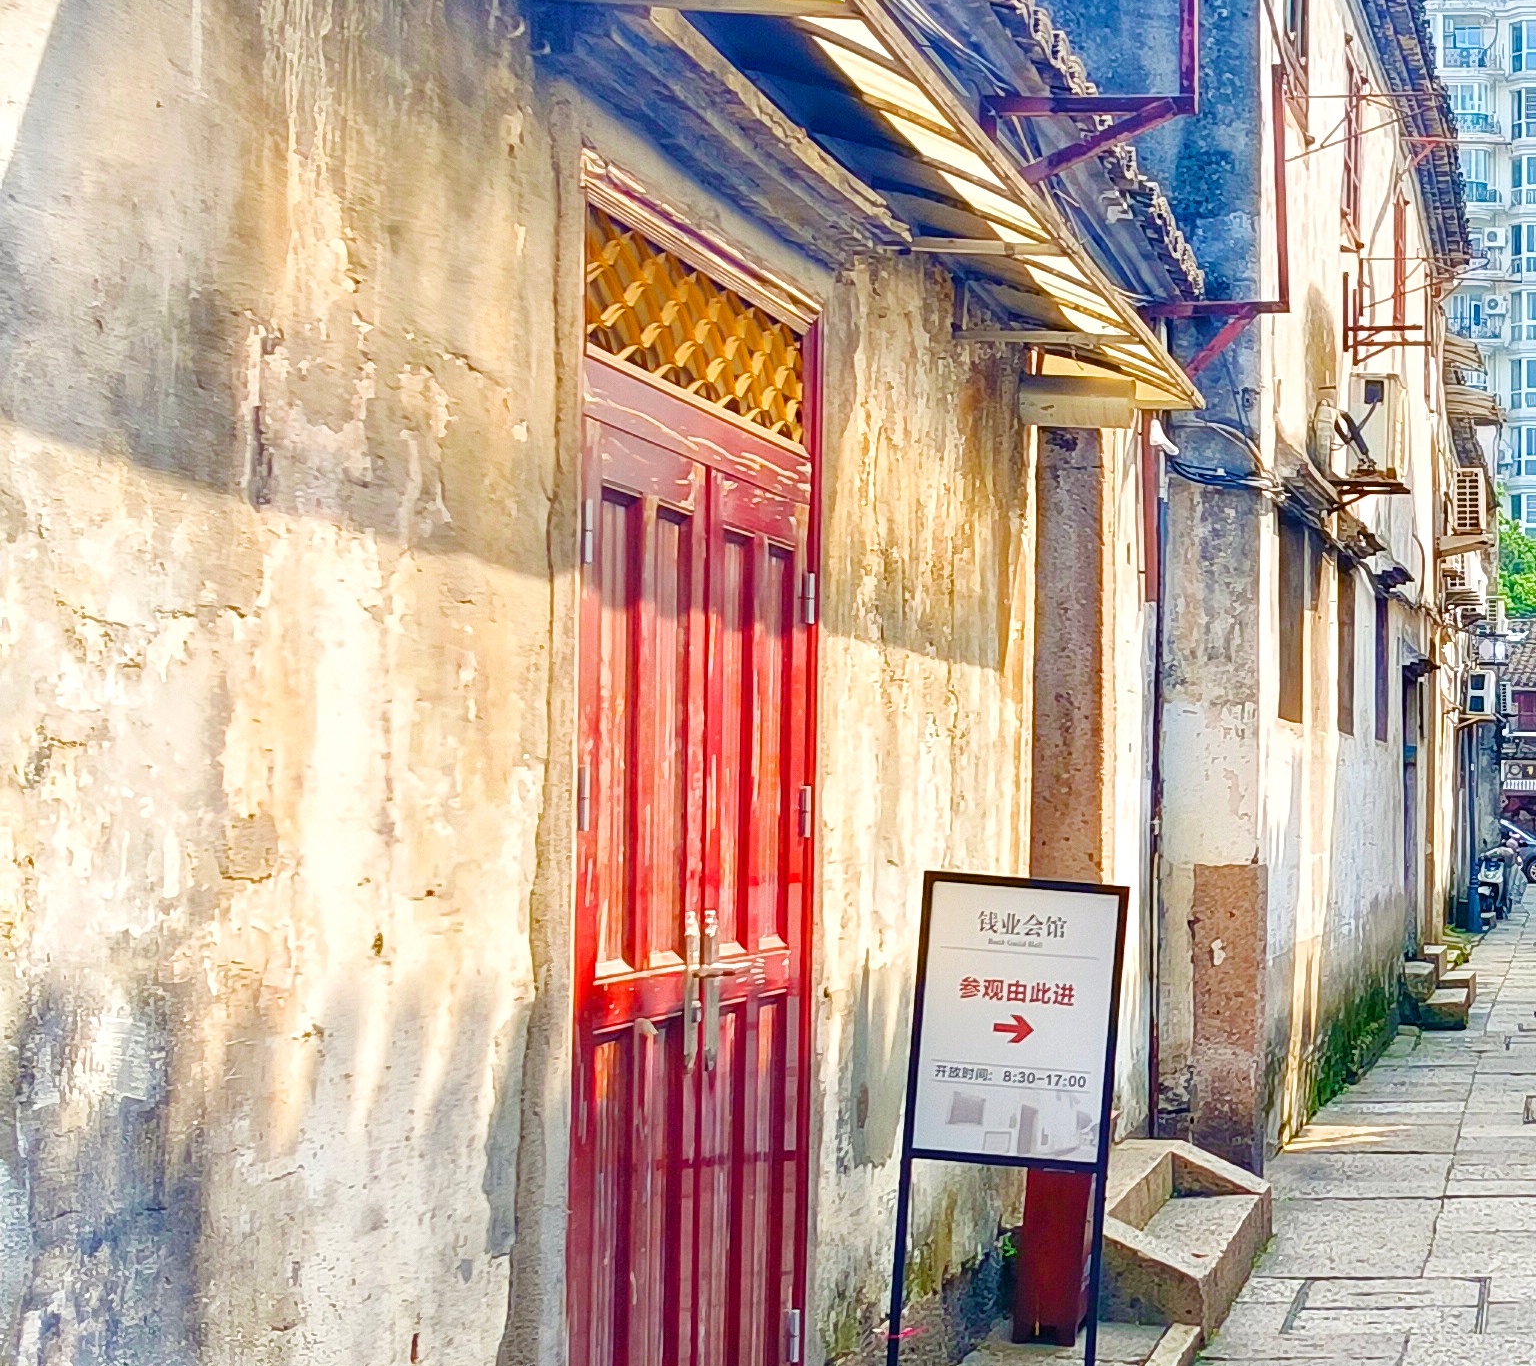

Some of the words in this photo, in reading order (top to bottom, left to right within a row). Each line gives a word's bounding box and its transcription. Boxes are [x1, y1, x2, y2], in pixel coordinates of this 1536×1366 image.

[978, 910, 1067, 939] 钱业会馆
[959, 976, 1075, 1006] 参观由此进
[1002, 1070, 1087, 1088] 8:30-17:00
